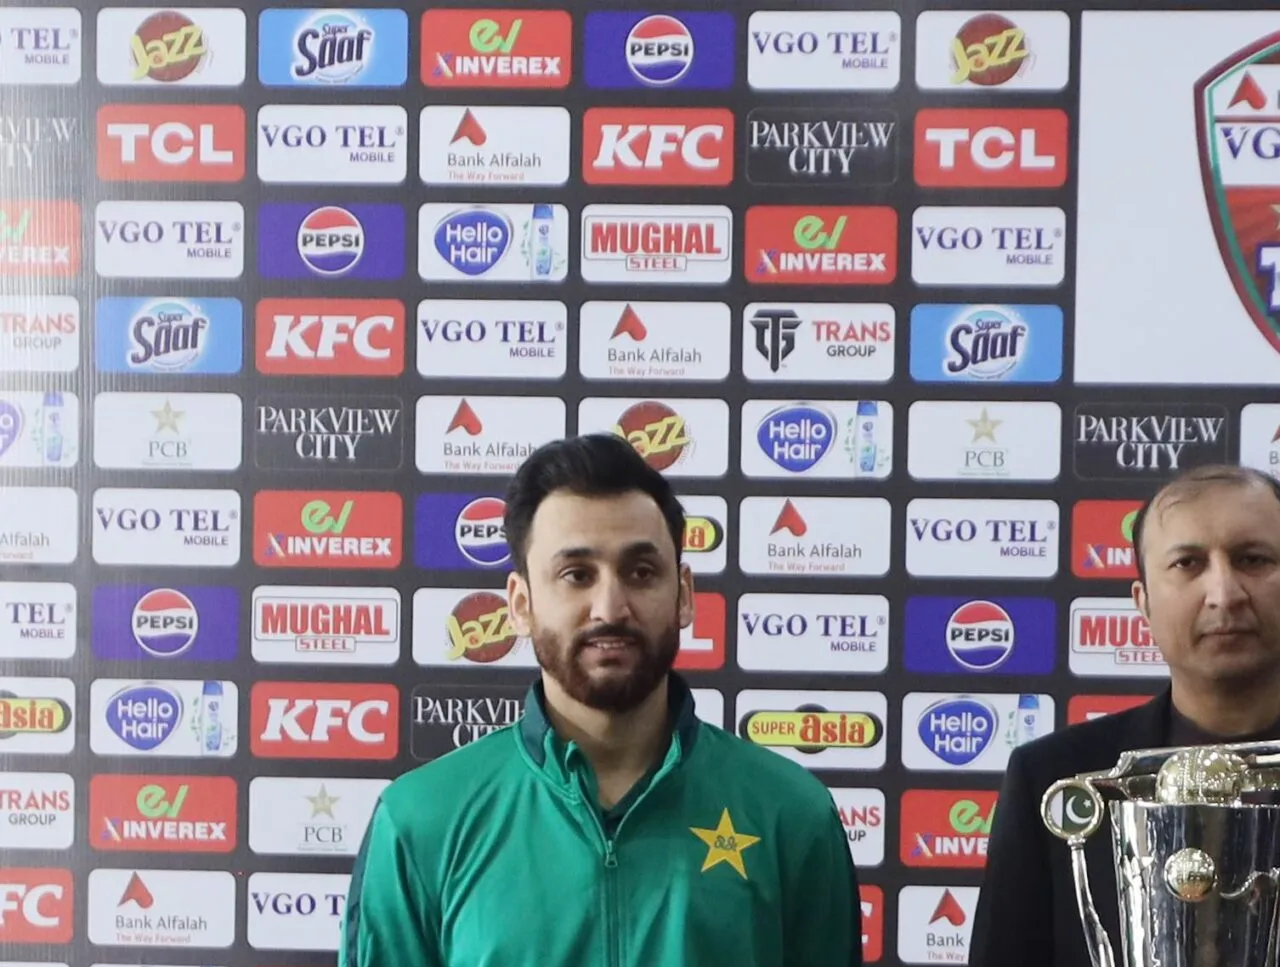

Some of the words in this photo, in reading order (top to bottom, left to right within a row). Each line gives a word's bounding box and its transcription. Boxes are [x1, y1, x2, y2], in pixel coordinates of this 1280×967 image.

[455, 56, 560, 76] INVEREX
[107, 123, 233, 164] TCL
[261, 125, 326, 148] VGO
[593, 124, 724, 169] KFC
[349, 152, 395, 163] MOBILE
[448, 153, 484, 167] Bank
[489, 153, 541, 167] Alfalah
[789, 148, 856, 175] CITY
[302, 234, 360, 248] PEPSI
[446, 222, 502, 244] Hello
[591, 222, 722, 254] MUGHAL
[450, 244, 498, 264] Hair
[630, 258, 681, 270] STEEL
[266, 315, 394, 359] KFC
[812, 320, 891, 342] TRANS
[827, 345, 876, 357] GROUP
[769, 418, 826, 440] Hello
[149, 440, 188, 457] PCB
[296, 433, 362, 460] CITY
[773, 440, 822, 461] Hair
[965, 450, 1005, 467] PCB
[910, 519, 976, 543] VGO
[287, 537, 391, 556] INVEREX
[768, 543, 805, 558] Bank
[810, 543, 862, 558] Alfalah
[1000, 547, 1047, 558] MOBILE
[136, 616, 193, 630] PEPSI
[262, 604, 390, 635] MUGHAL
[300, 639, 350, 651] STEEL
[951, 629, 1009, 643] PEPSI
[261, 699, 389, 743] KFC
[752, 720, 795, 736] SUPER
[799, 714, 865, 744] asia
[123, 821, 225, 840] INVEREX
[935, 837, 989, 856] INVE
[116, 916, 151, 929] Bank
[156, 916, 206, 929] Alfalah
